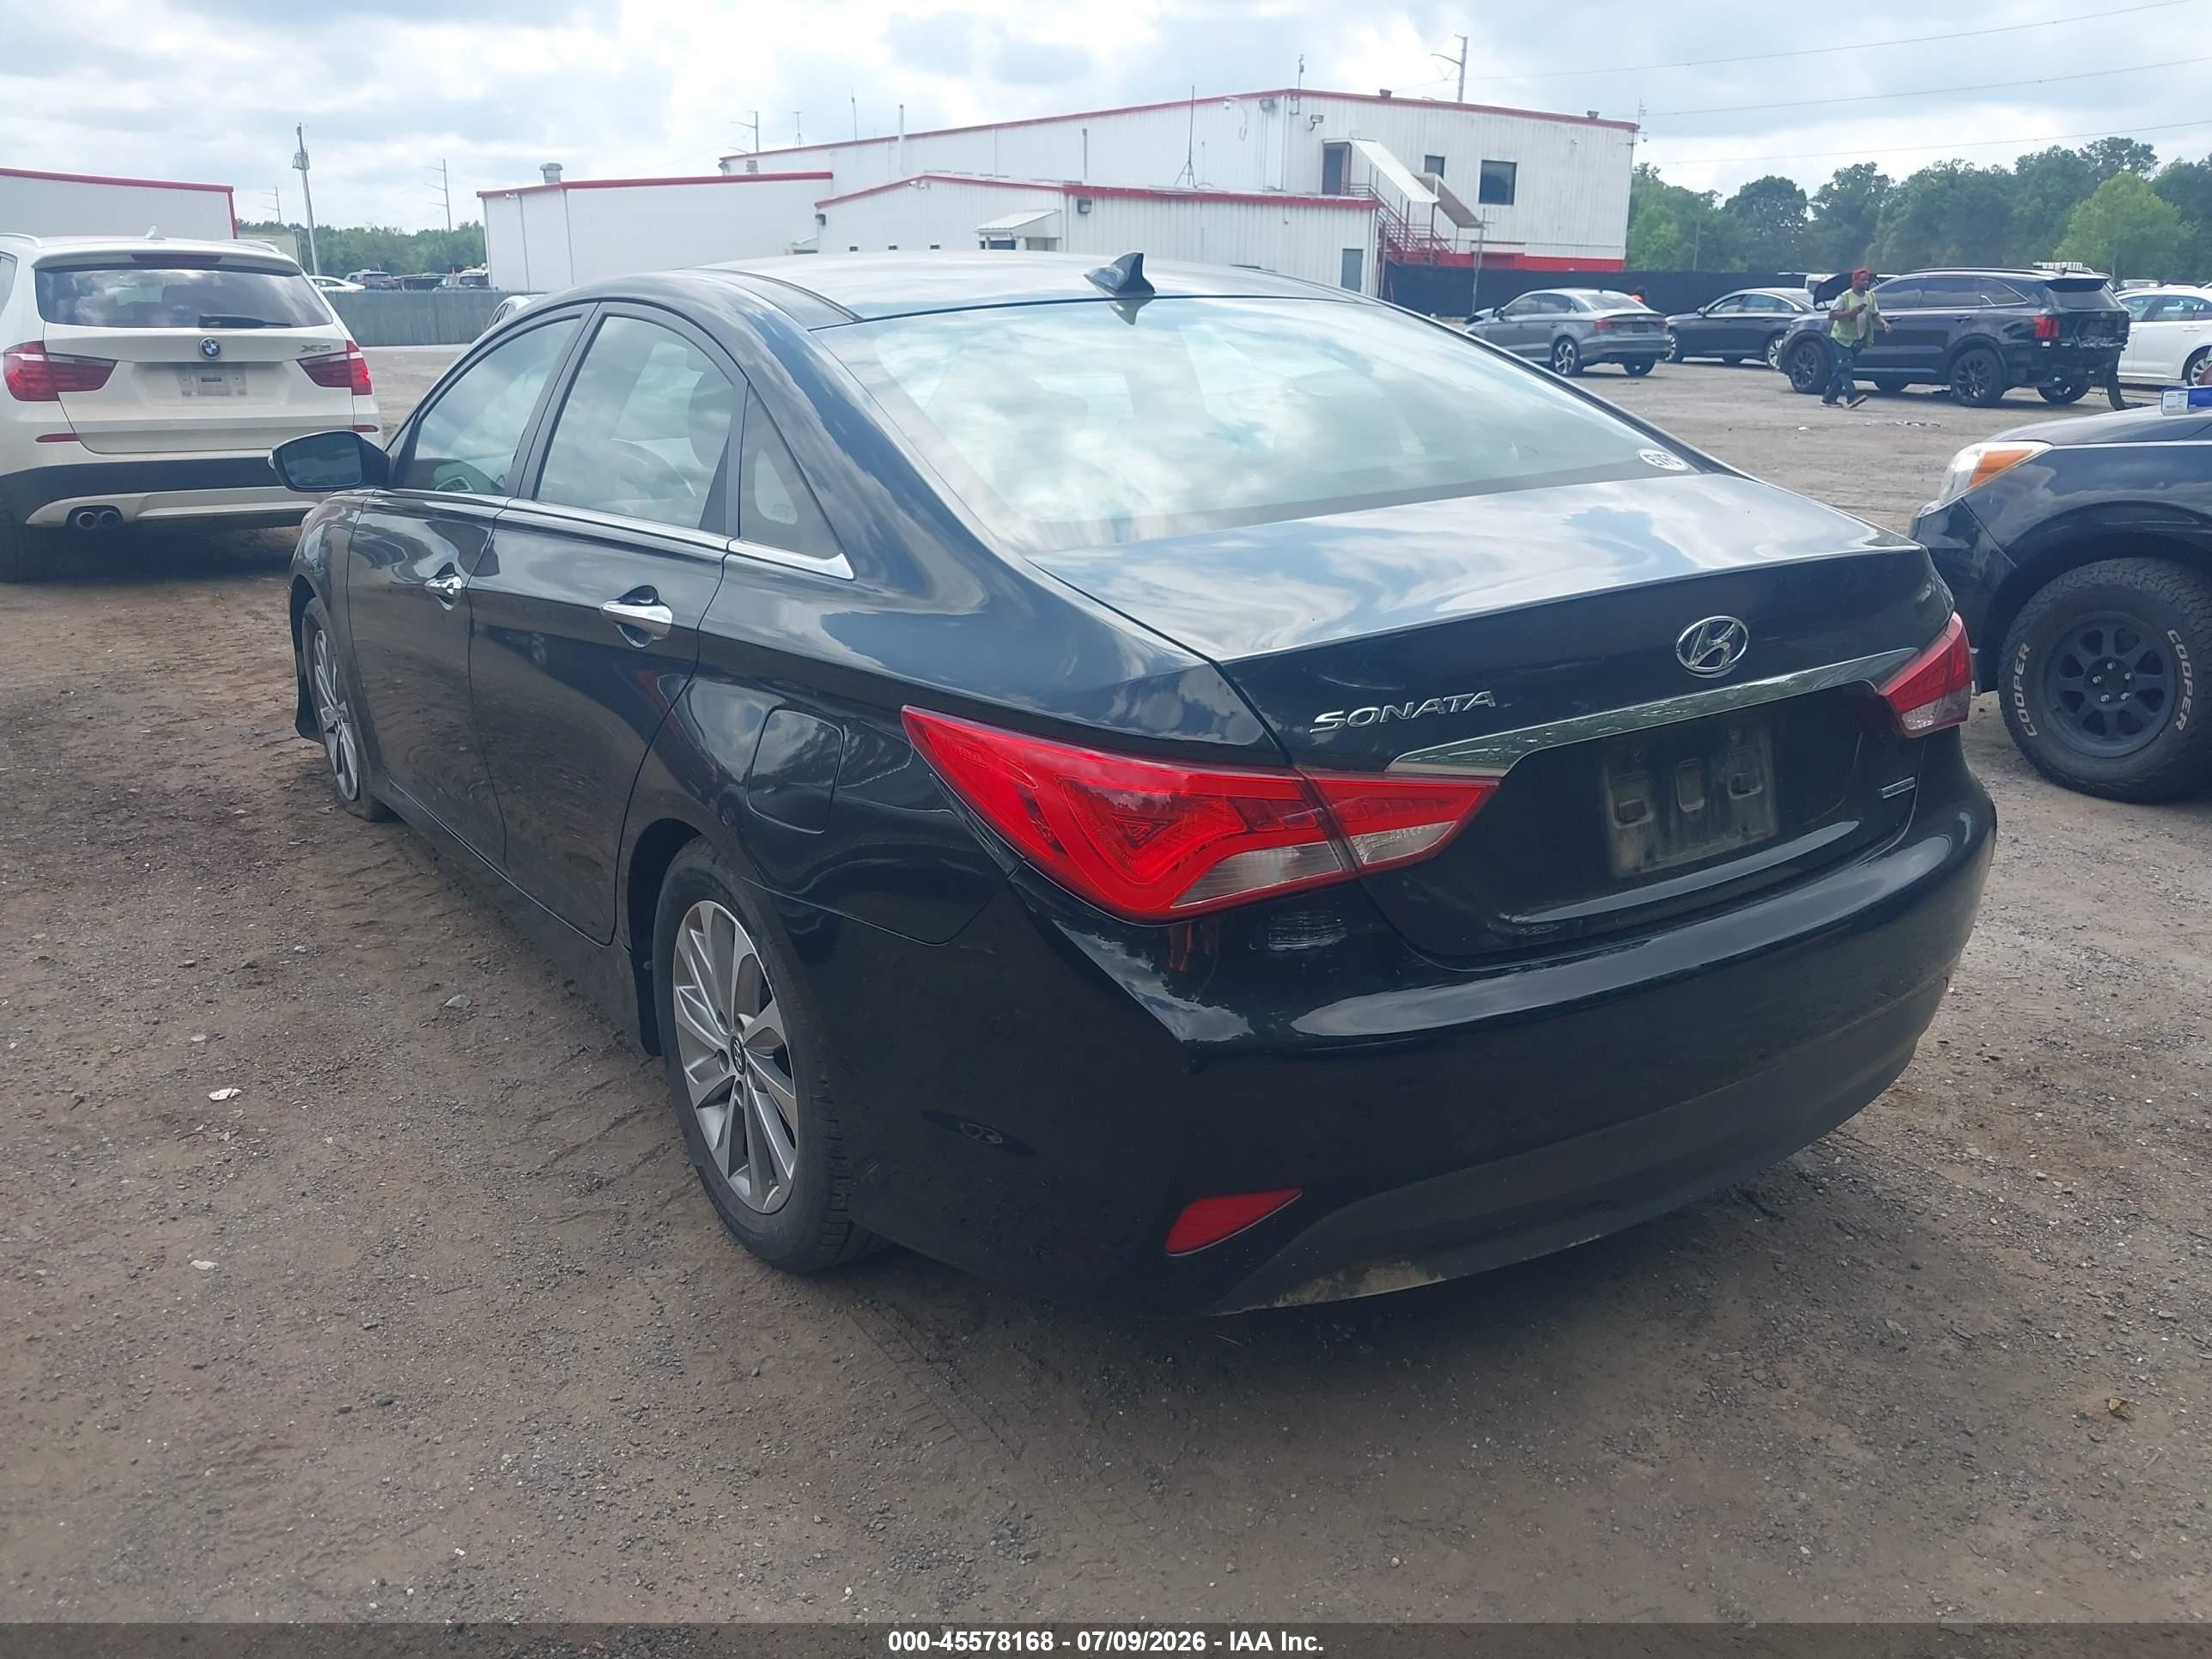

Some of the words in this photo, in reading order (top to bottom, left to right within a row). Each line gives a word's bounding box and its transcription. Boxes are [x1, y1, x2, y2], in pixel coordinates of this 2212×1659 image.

[1310, 690, 1497, 733] SONATA
[2013, 642, 2038, 737] COOPER
[2166, 629, 2193, 730] COOPER
